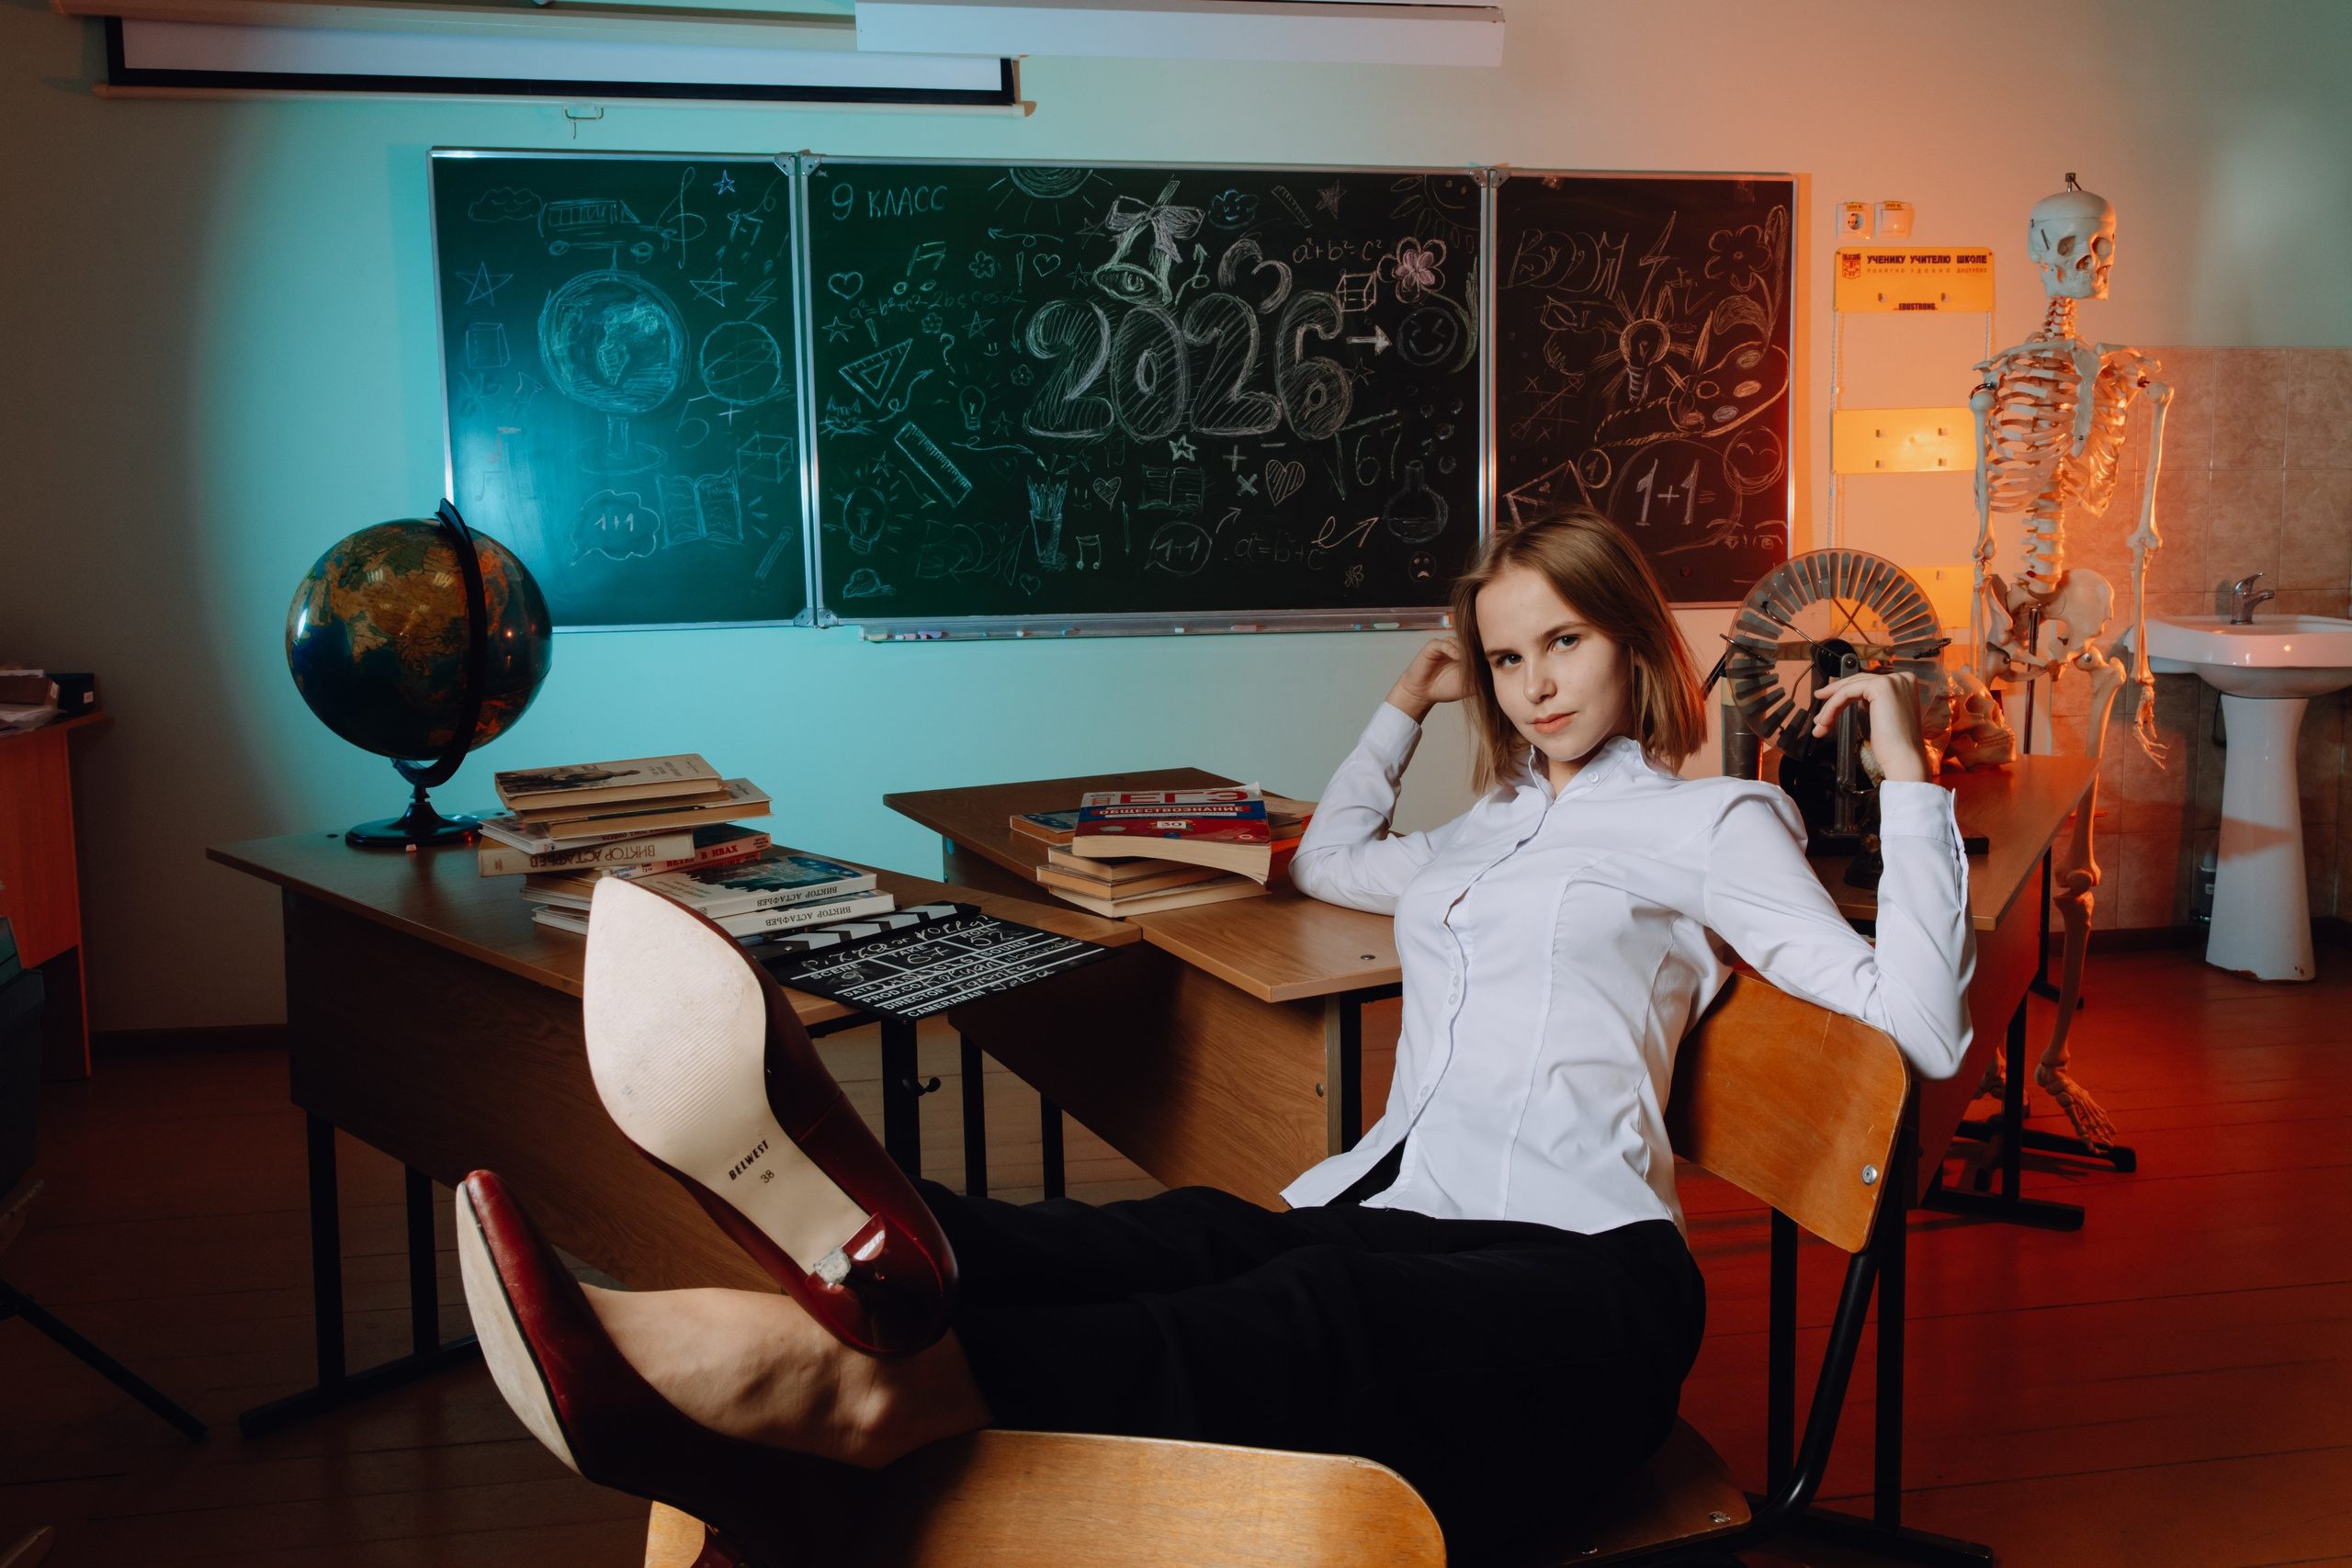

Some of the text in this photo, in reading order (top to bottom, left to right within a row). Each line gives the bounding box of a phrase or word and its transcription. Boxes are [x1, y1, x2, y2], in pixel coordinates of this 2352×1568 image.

[831, 183, 948, 220] 9 КЛАСС
[1867, 255, 1905, 265] УЧЕНИКУ
[1910, 255, 1951, 265] УЧИТЕЛЮ
[1957, 255, 1987, 265] ШКОЛЕ
[1021, 290, 1353, 441] 2026
[1120, 790, 1249, 805] ЕГЭ
[1099, 806, 1243, 816] ОБЩЕСТВОЗНАНИЕ
[529, 844, 655, 868] ВИКТОР АСТАФЬЕВ
[756, 886, 838, 907] ВИКТОР АСТАФЬЕВ
[765, 906, 852, 926] ВИКТОР АСТАФЬЕВ
[888, 944, 929, 957] TAKE
[980, 941, 1028, 956] SOUND
[810, 962, 862, 980] SCENE
[844, 986, 876, 997] DATE
[863, 983, 922, 1003] PROD.CO
[883, 988, 947, 1010] DIRECTOR
[907, 990, 987, 1017] CAMERAMAN
[729, 1139, 768, 1180] BELWEST
[761, 1170, 775, 1183] 38
